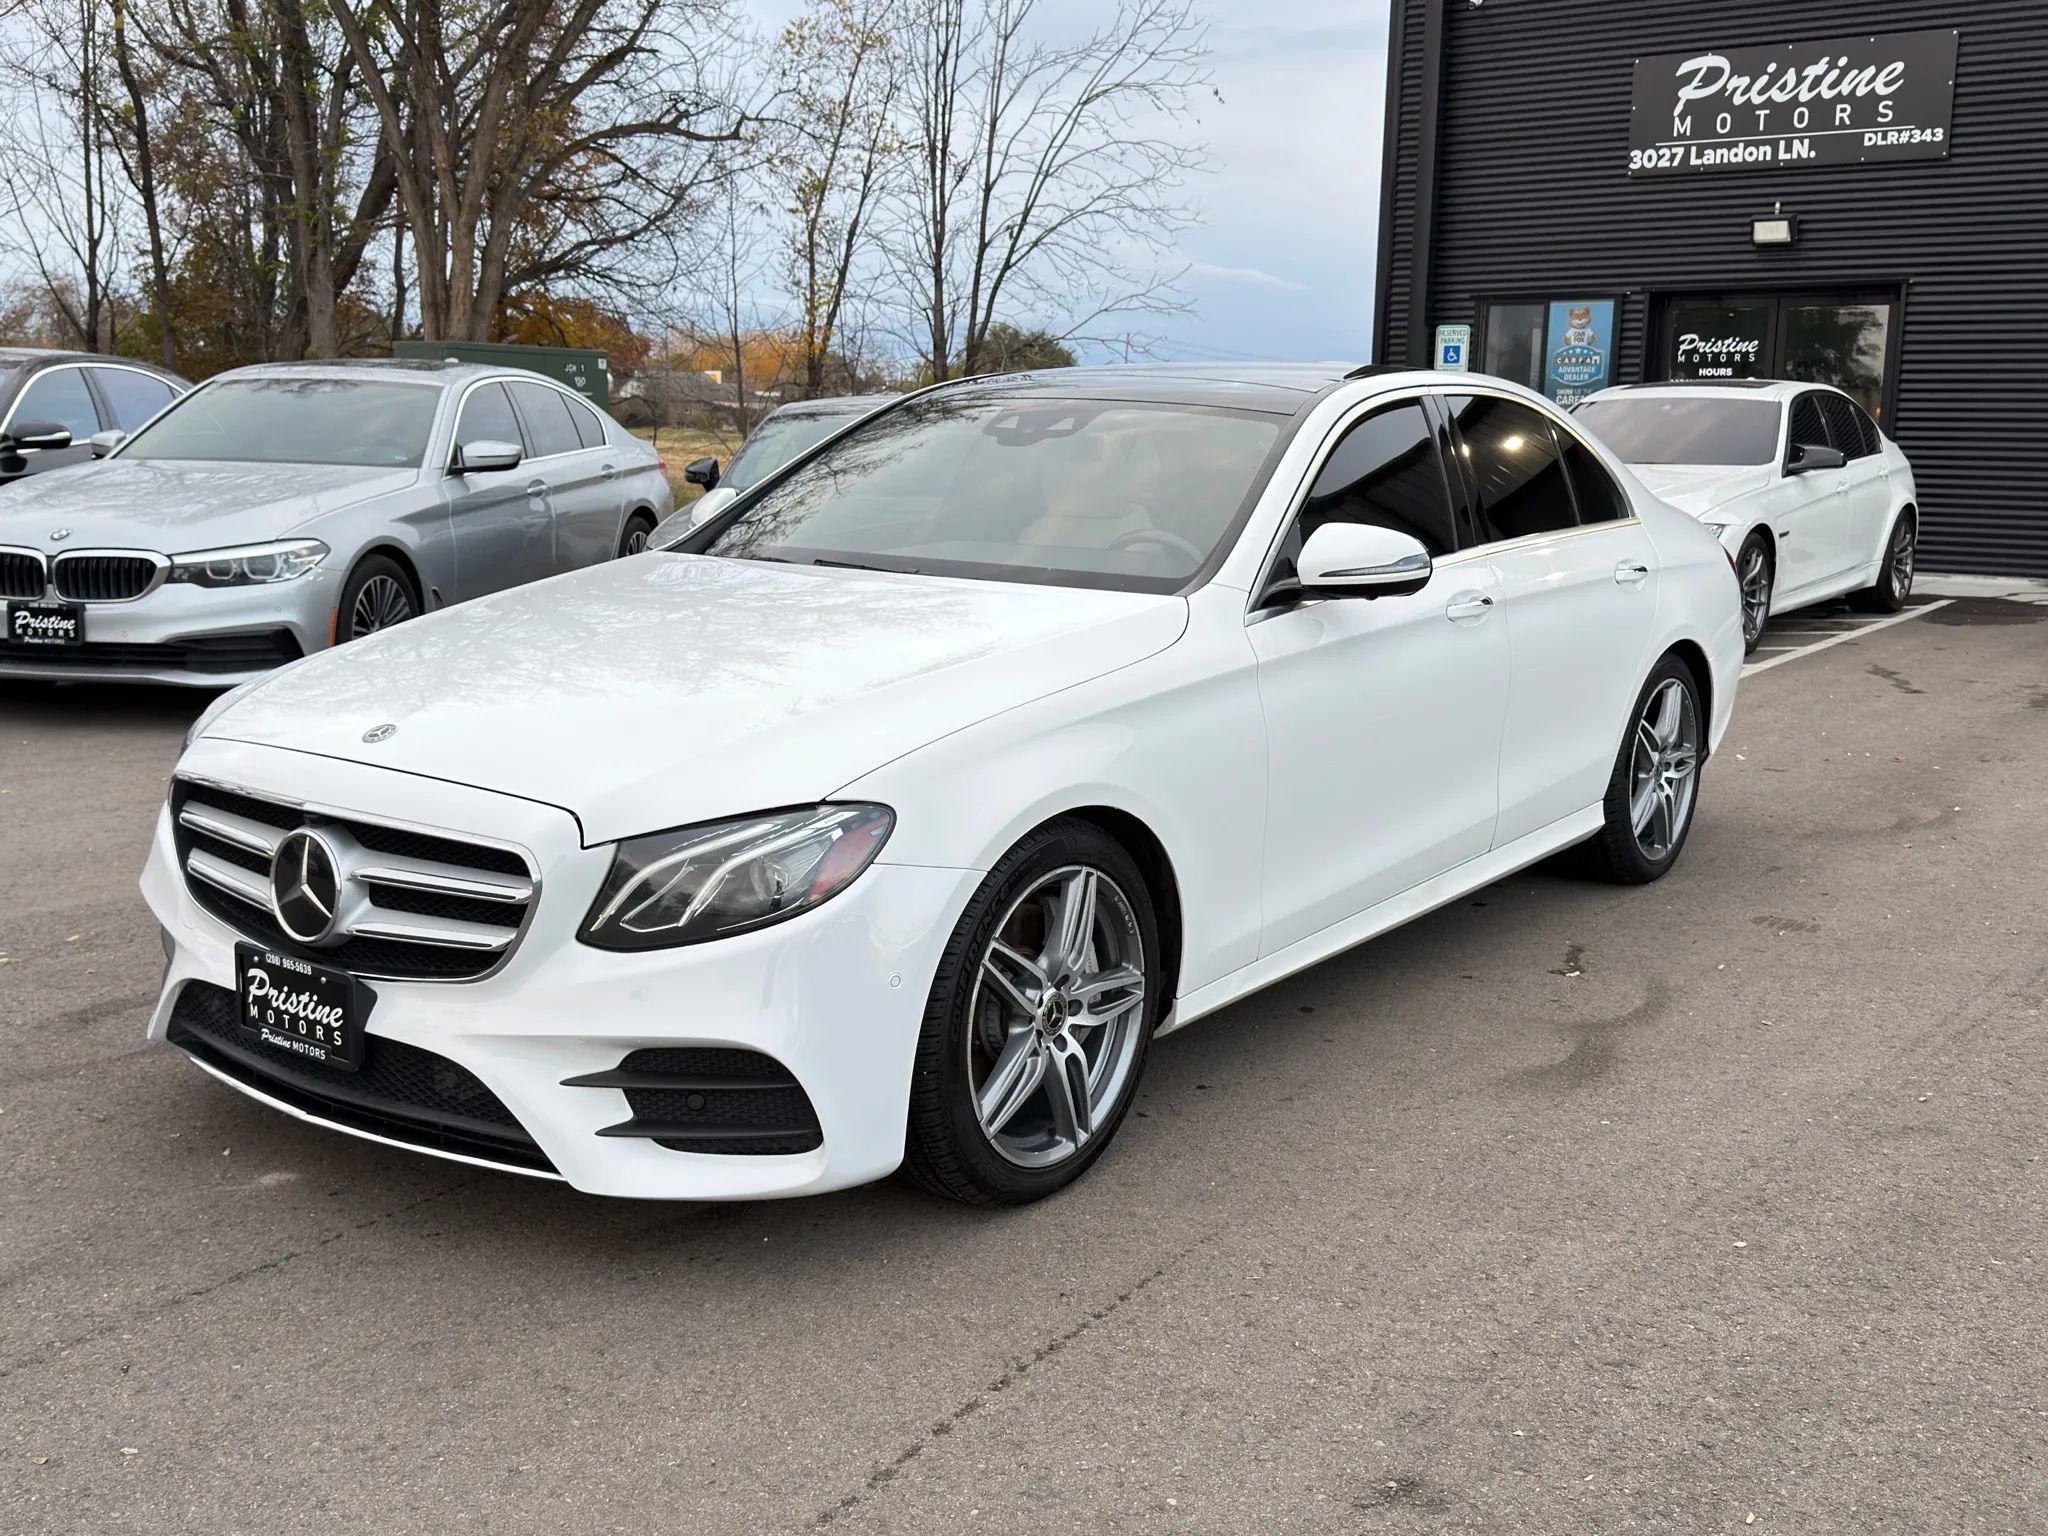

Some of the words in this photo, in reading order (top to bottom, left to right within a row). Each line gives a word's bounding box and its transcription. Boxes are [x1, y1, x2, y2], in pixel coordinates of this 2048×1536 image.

[1673, 54, 1904, 117] Pristine
[1673, 100, 1893, 137] MOTORS
[1864, 127, 1944, 147] DLR#343
[1629, 147, 1681, 169] 3027
[1690, 141, 1772, 165] Landon
[1779, 139, 1816, 161] LN.
[1438, 329, 1467, 337] RESERVED
[1440, 337, 1465, 345] PARKING
[1678, 333, 1759, 356] Pristine
[1556, 355, 1600, 365] CARFAX
[1677, 353, 1755, 363] MOTORS
[1698, 367, 1733, 376] HOURS
[14, 611, 76, 630] Pristine
[16, 627, 75, 638] MOTORS
[247, 968, 343, 1028] Pristine
[250, 1004, 342, 1046] MOTORS
[261, 1027, 292, 1049] Pristine
[292, 1040, 326, 1060] MOTORS
